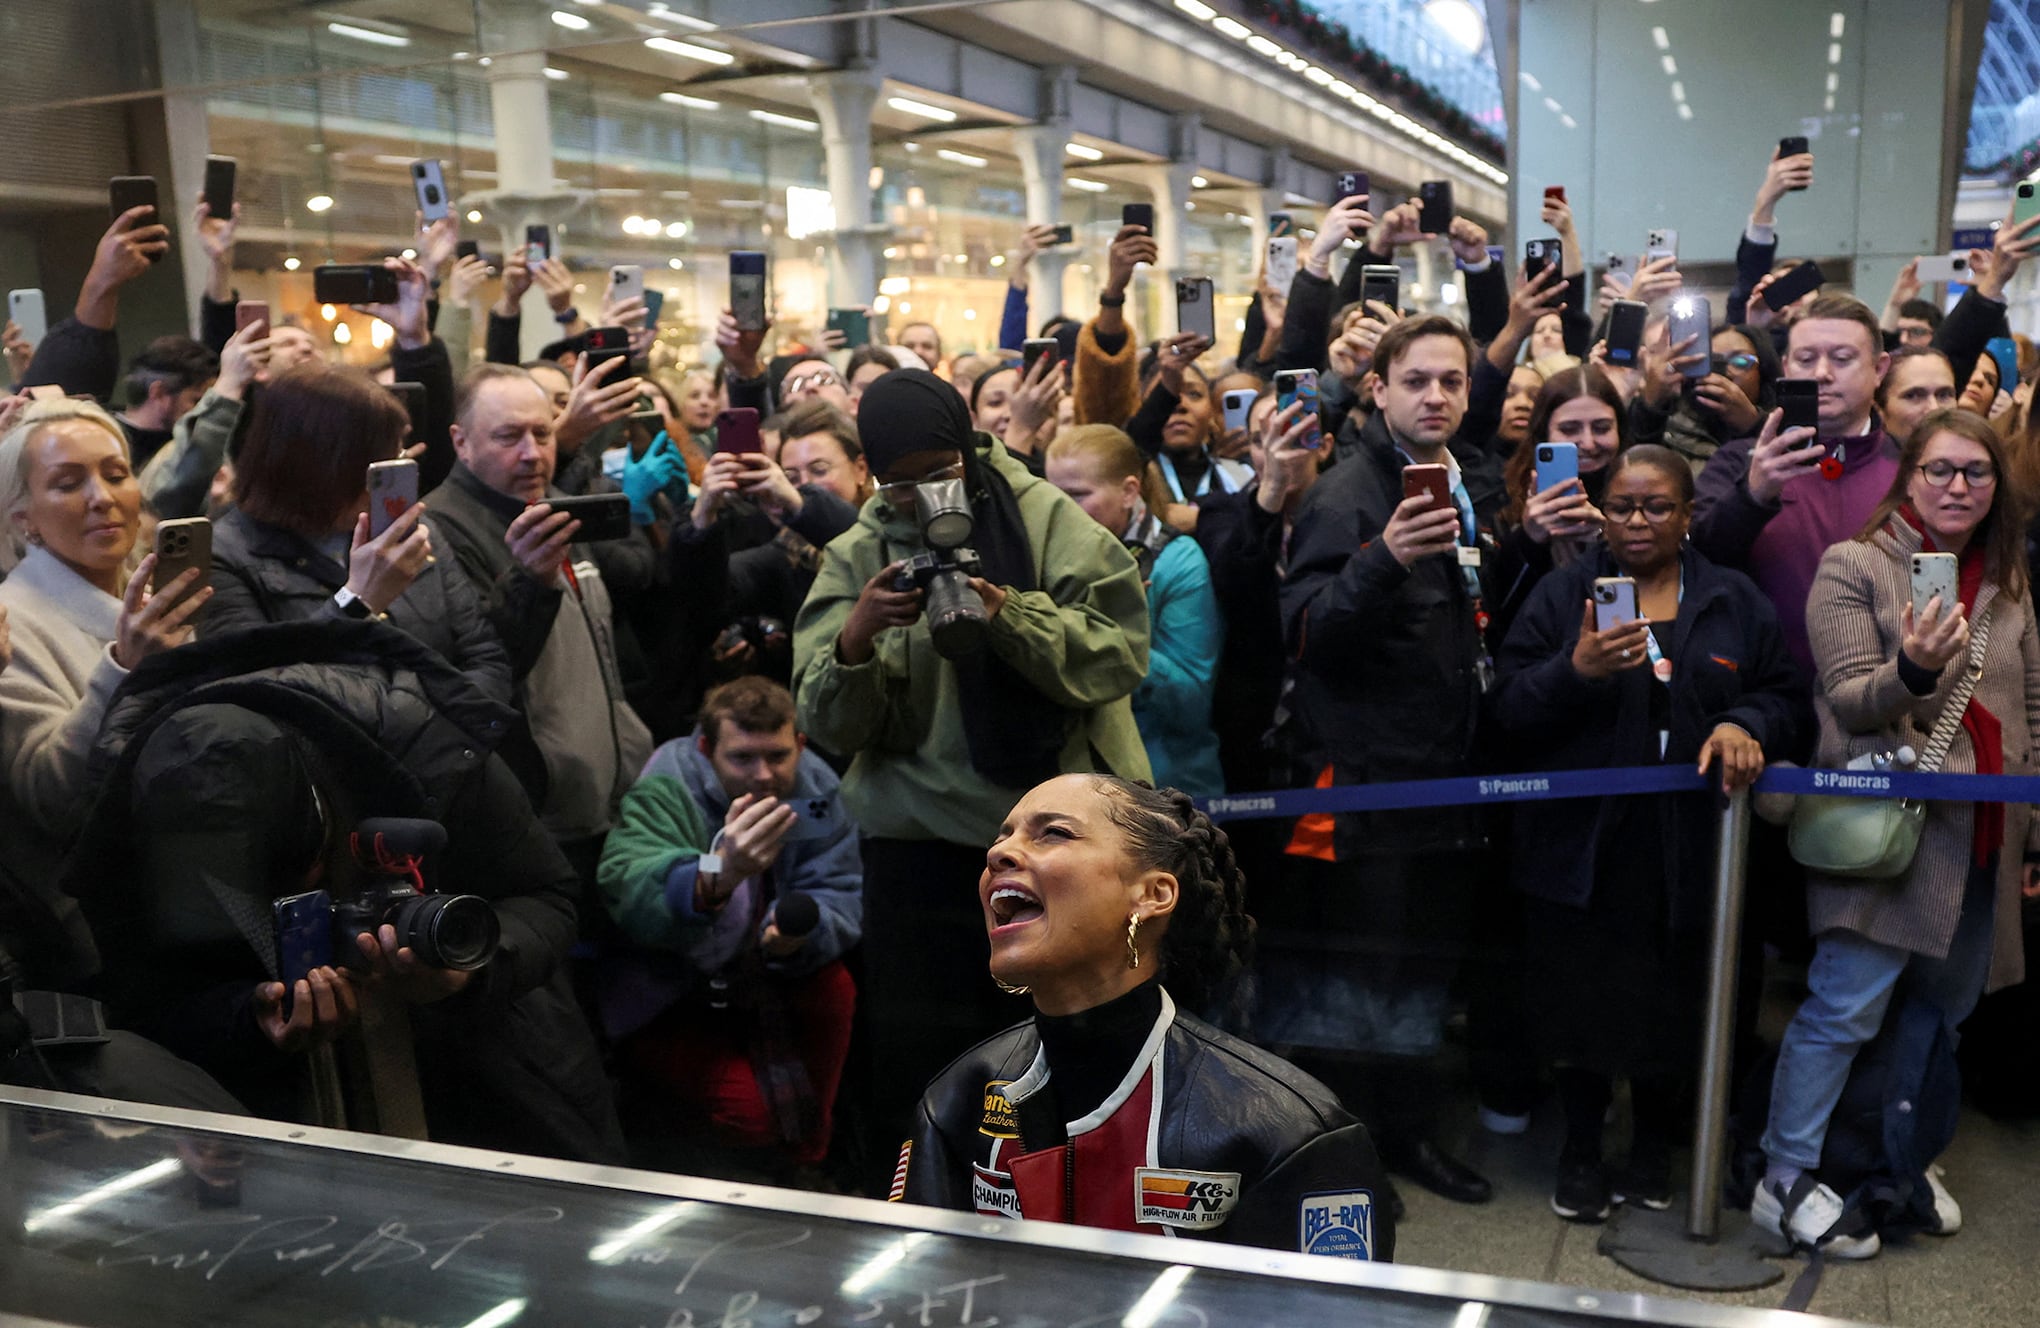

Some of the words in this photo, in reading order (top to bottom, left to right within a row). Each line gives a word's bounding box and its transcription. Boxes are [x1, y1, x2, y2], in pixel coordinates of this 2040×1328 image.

[1142, 1208, 1180, 1220] HIGH-FLOW
[1182, 1211, 1196, 1221] AIR
[1305, 1204, 1370, 1247] BEL-RAY
[1329, 1234, 1347, 1242] TOTAL
